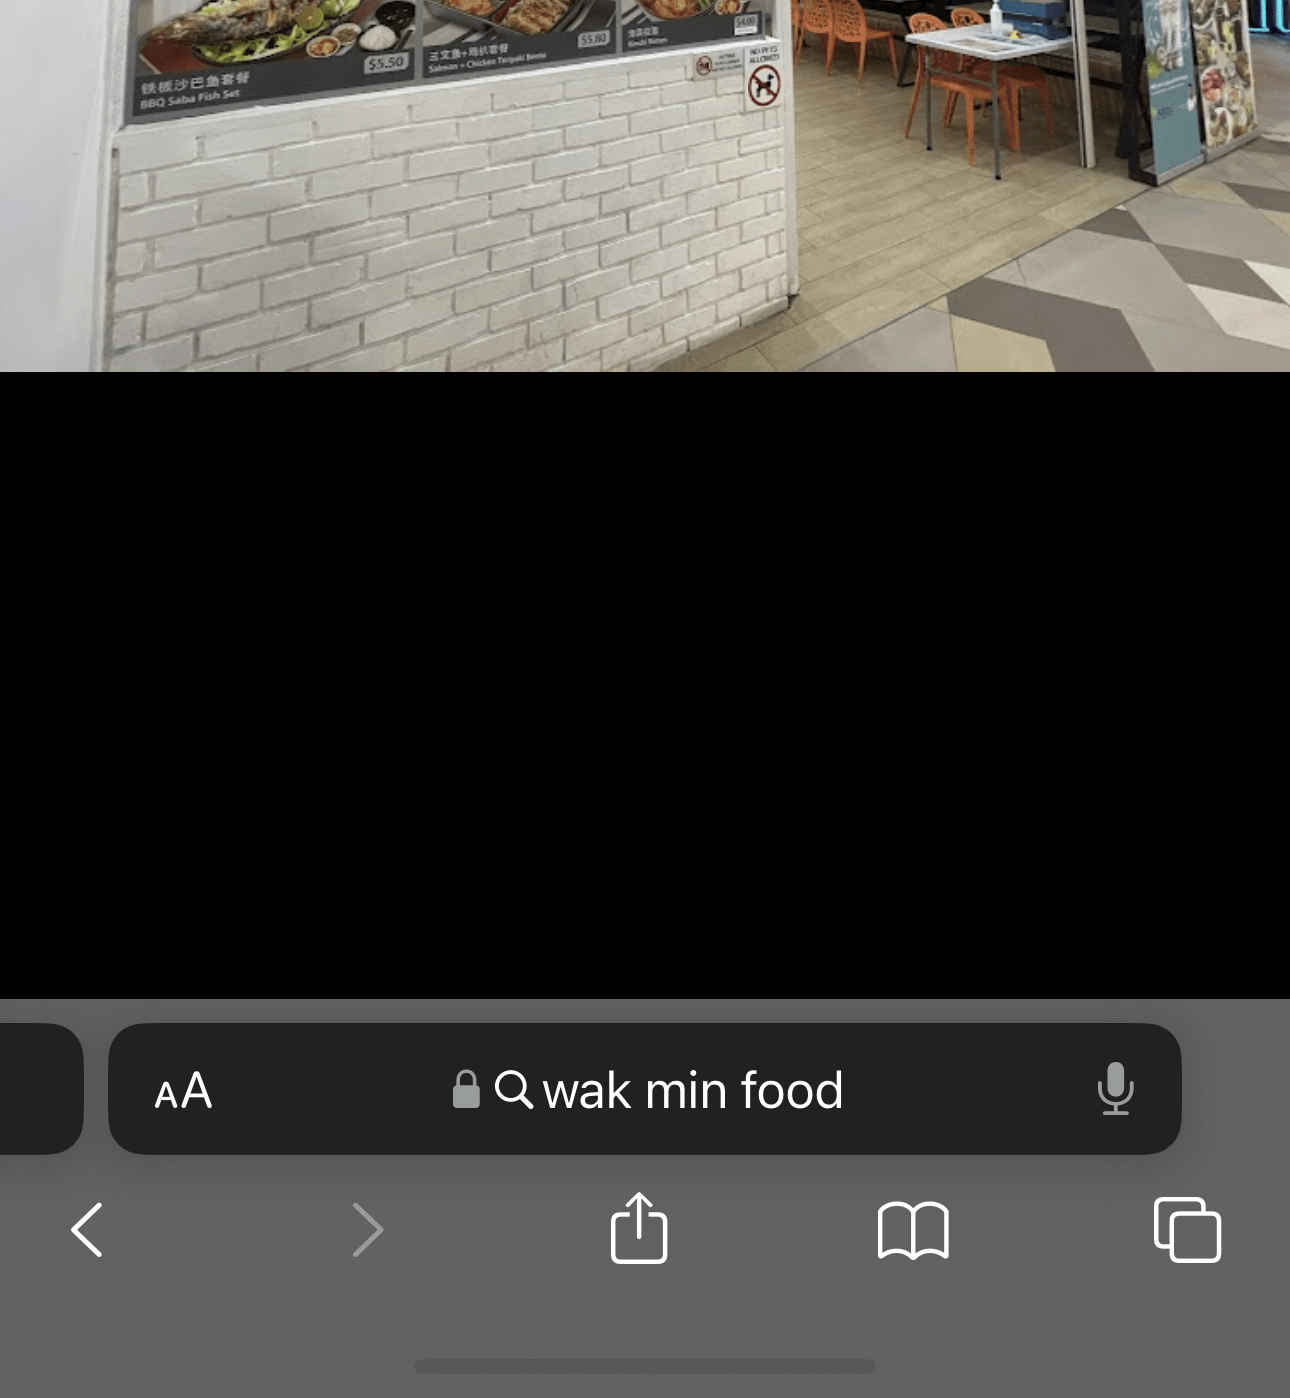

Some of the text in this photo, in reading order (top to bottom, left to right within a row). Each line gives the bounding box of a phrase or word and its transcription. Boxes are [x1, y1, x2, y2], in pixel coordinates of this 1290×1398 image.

[368, 55, 404, 72] $5.50
[428, 62, 459, 74] Salmon
[466, 58, 496, 69] Chicken
[140, 88, 241, 110] BBQ Saba Fish Set
